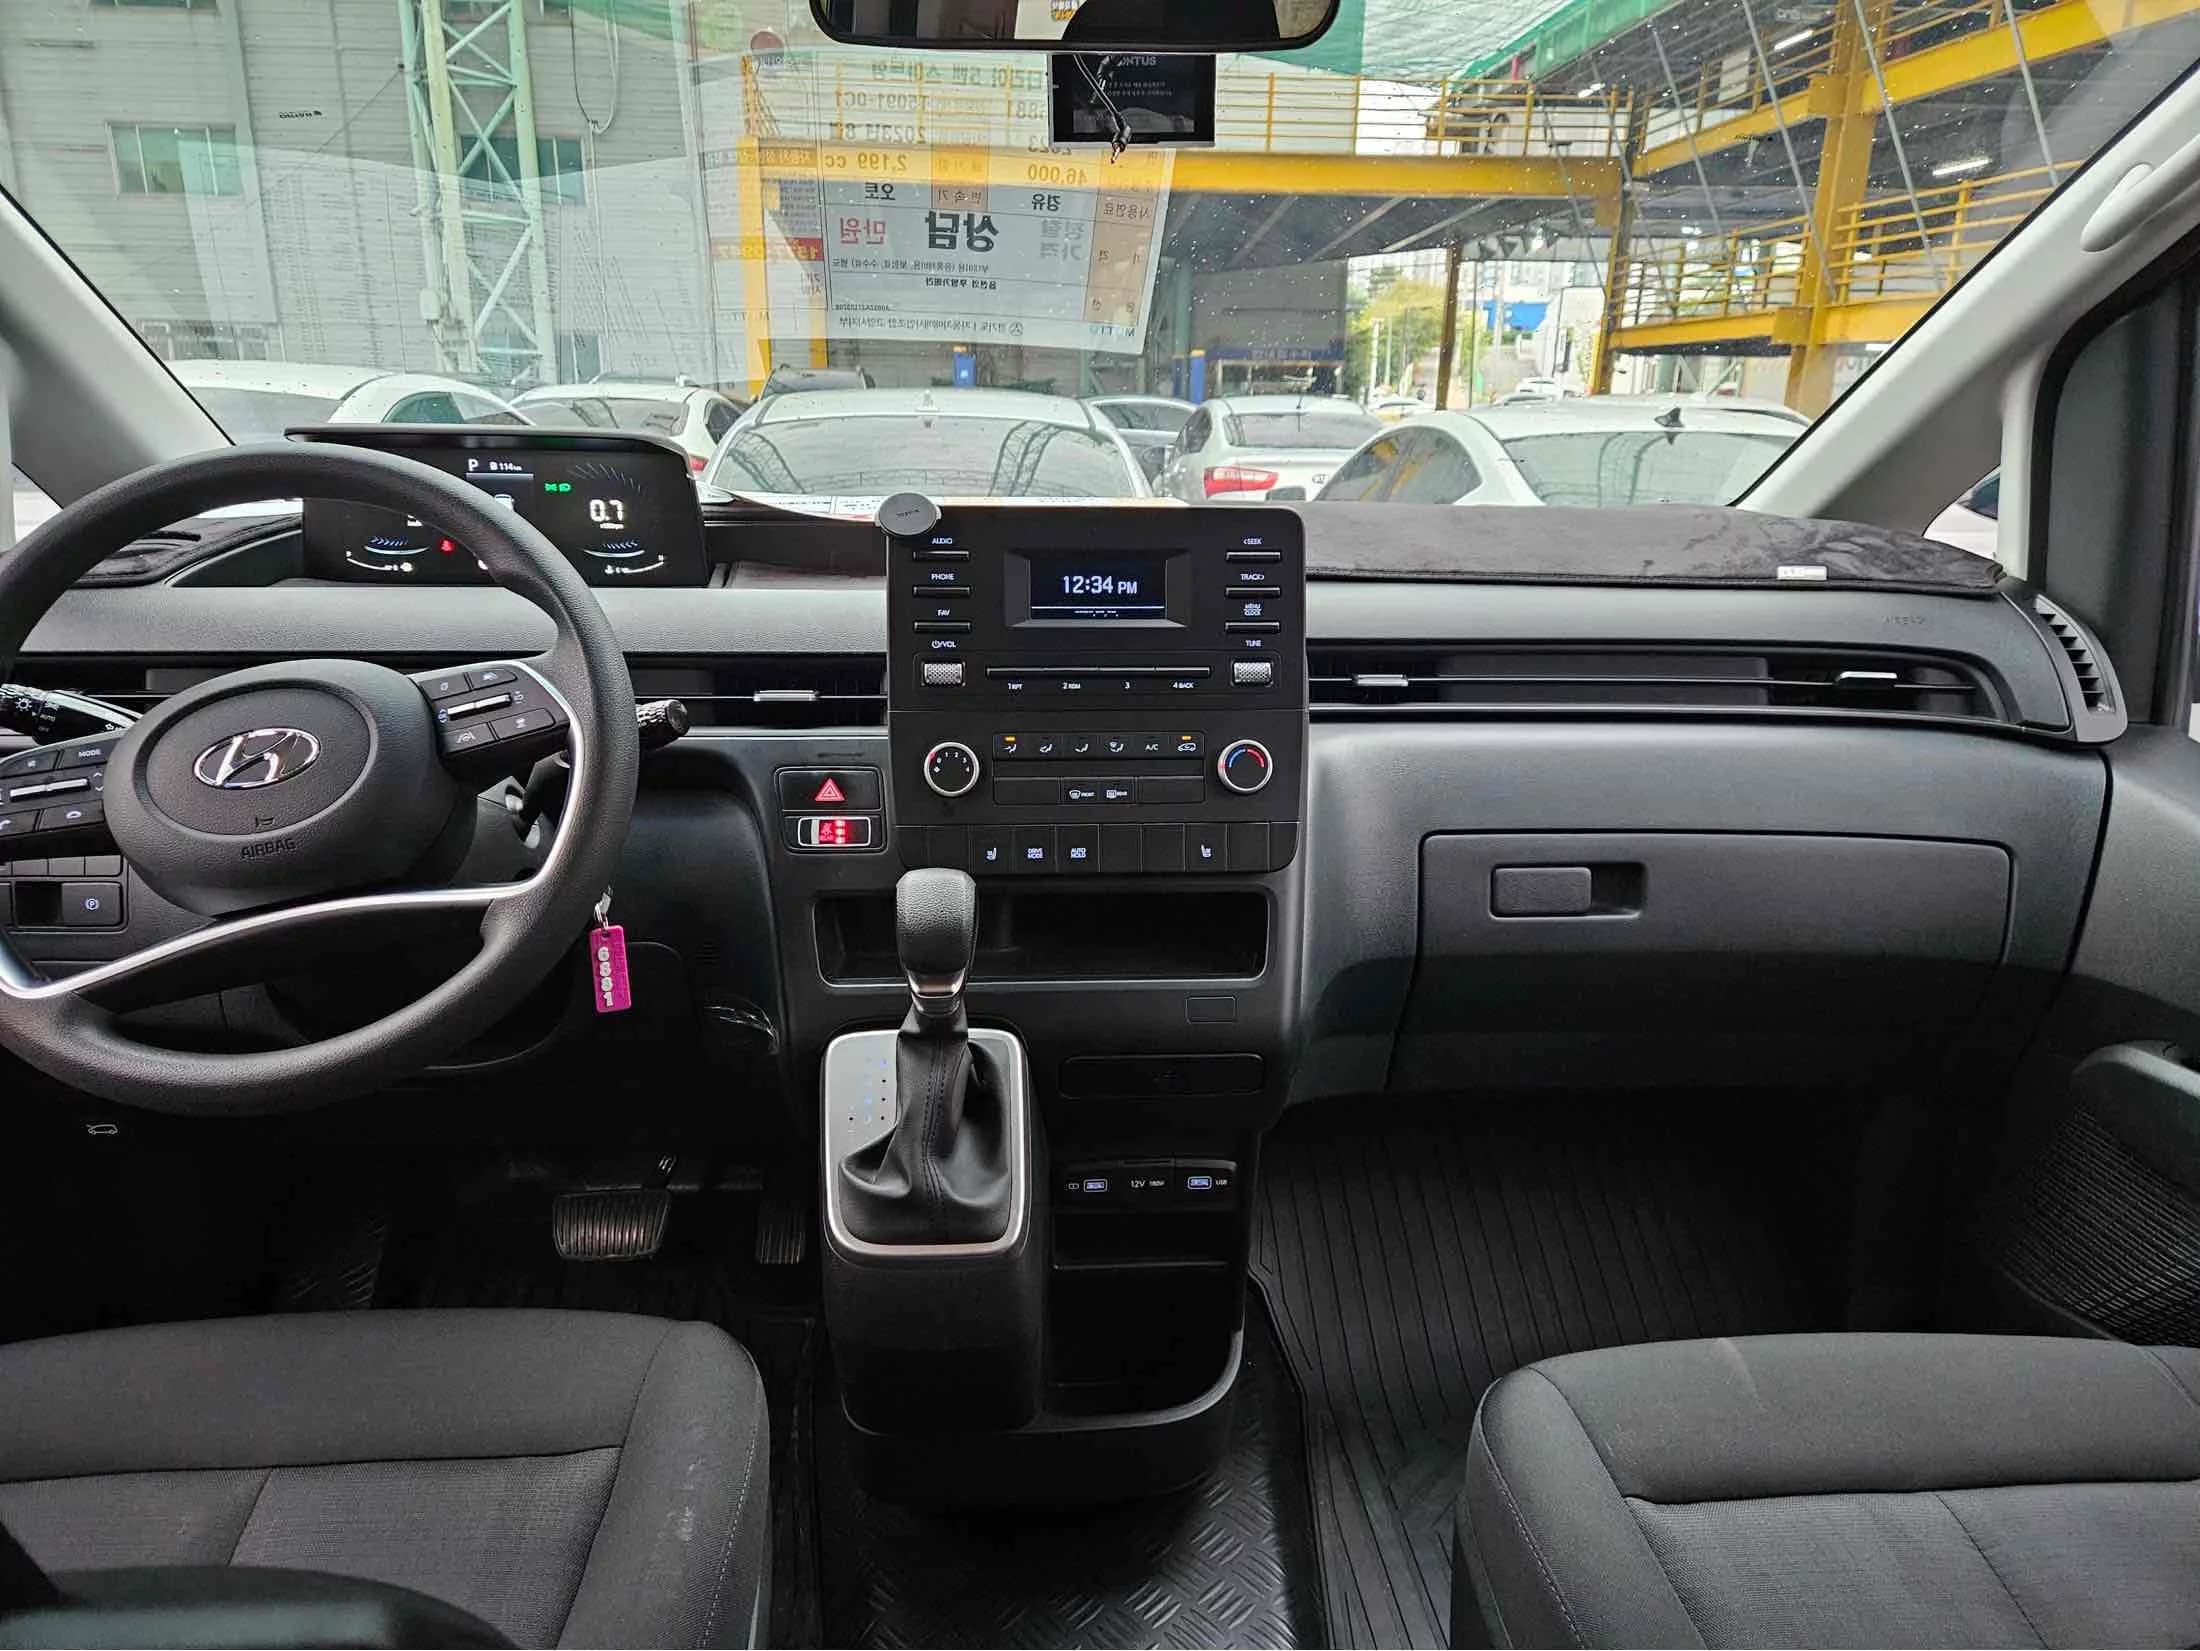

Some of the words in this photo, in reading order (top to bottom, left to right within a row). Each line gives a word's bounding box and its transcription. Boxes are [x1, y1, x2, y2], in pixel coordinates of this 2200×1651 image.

[468, 459, 479, 471] P
[590, 499, 624, 522] 0.7
[931, 537, 953, 545] AUDIO
[931, 573, 955, 581] PHONE
[1063, 575, 1114, 595] 12:34
[1117, 580, 1138, 595] PM
[937, 609, 951, 617] FAV
[1144, 743, 1159, 751] A/C
[78, 748, 101, 758] MODE
[241, 837, 296, 860] AIRBAG
[1130, 1179, 1146, 1188] 12V
